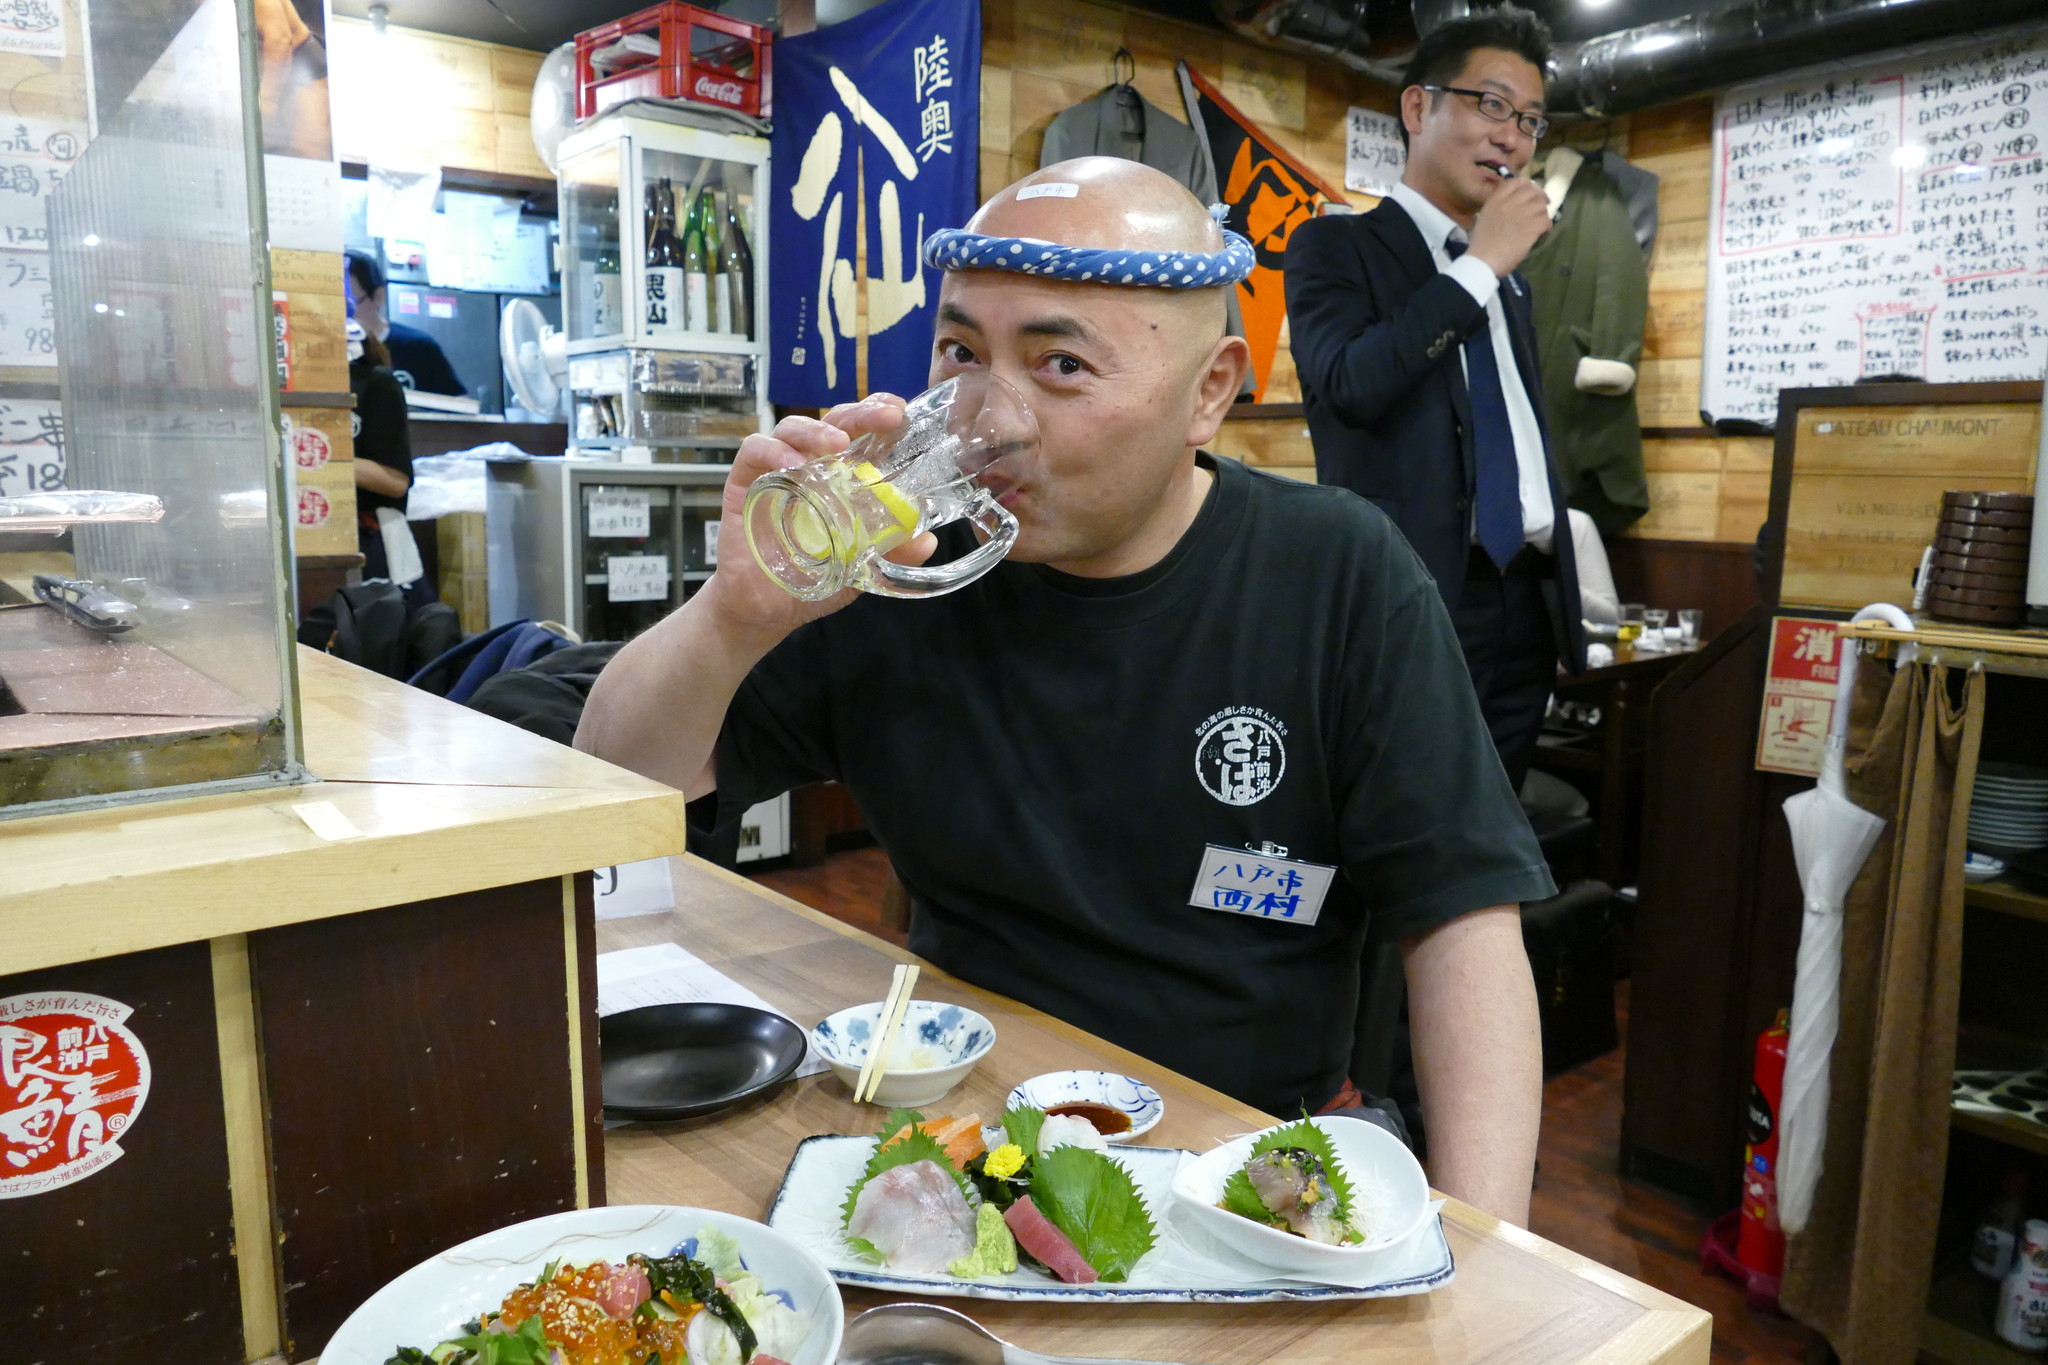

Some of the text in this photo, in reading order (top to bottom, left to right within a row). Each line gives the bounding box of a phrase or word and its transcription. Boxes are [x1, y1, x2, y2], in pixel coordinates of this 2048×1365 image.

[695, 76, 743, 104] Coca-Cola
[914, 34, 953, 163] 陸奥
[791, 66, 926, 390] 八仙
[1811, 418, 2001, 437] CATEAU CHAUMONT
[1792, 626, 1836, 663] 消
[1256, 728, 1272, 794] 八戸前沖
[1213, 863, 1305, 896] 八戸市
[58, 1025, 109, 1071] 八戸 前沖
